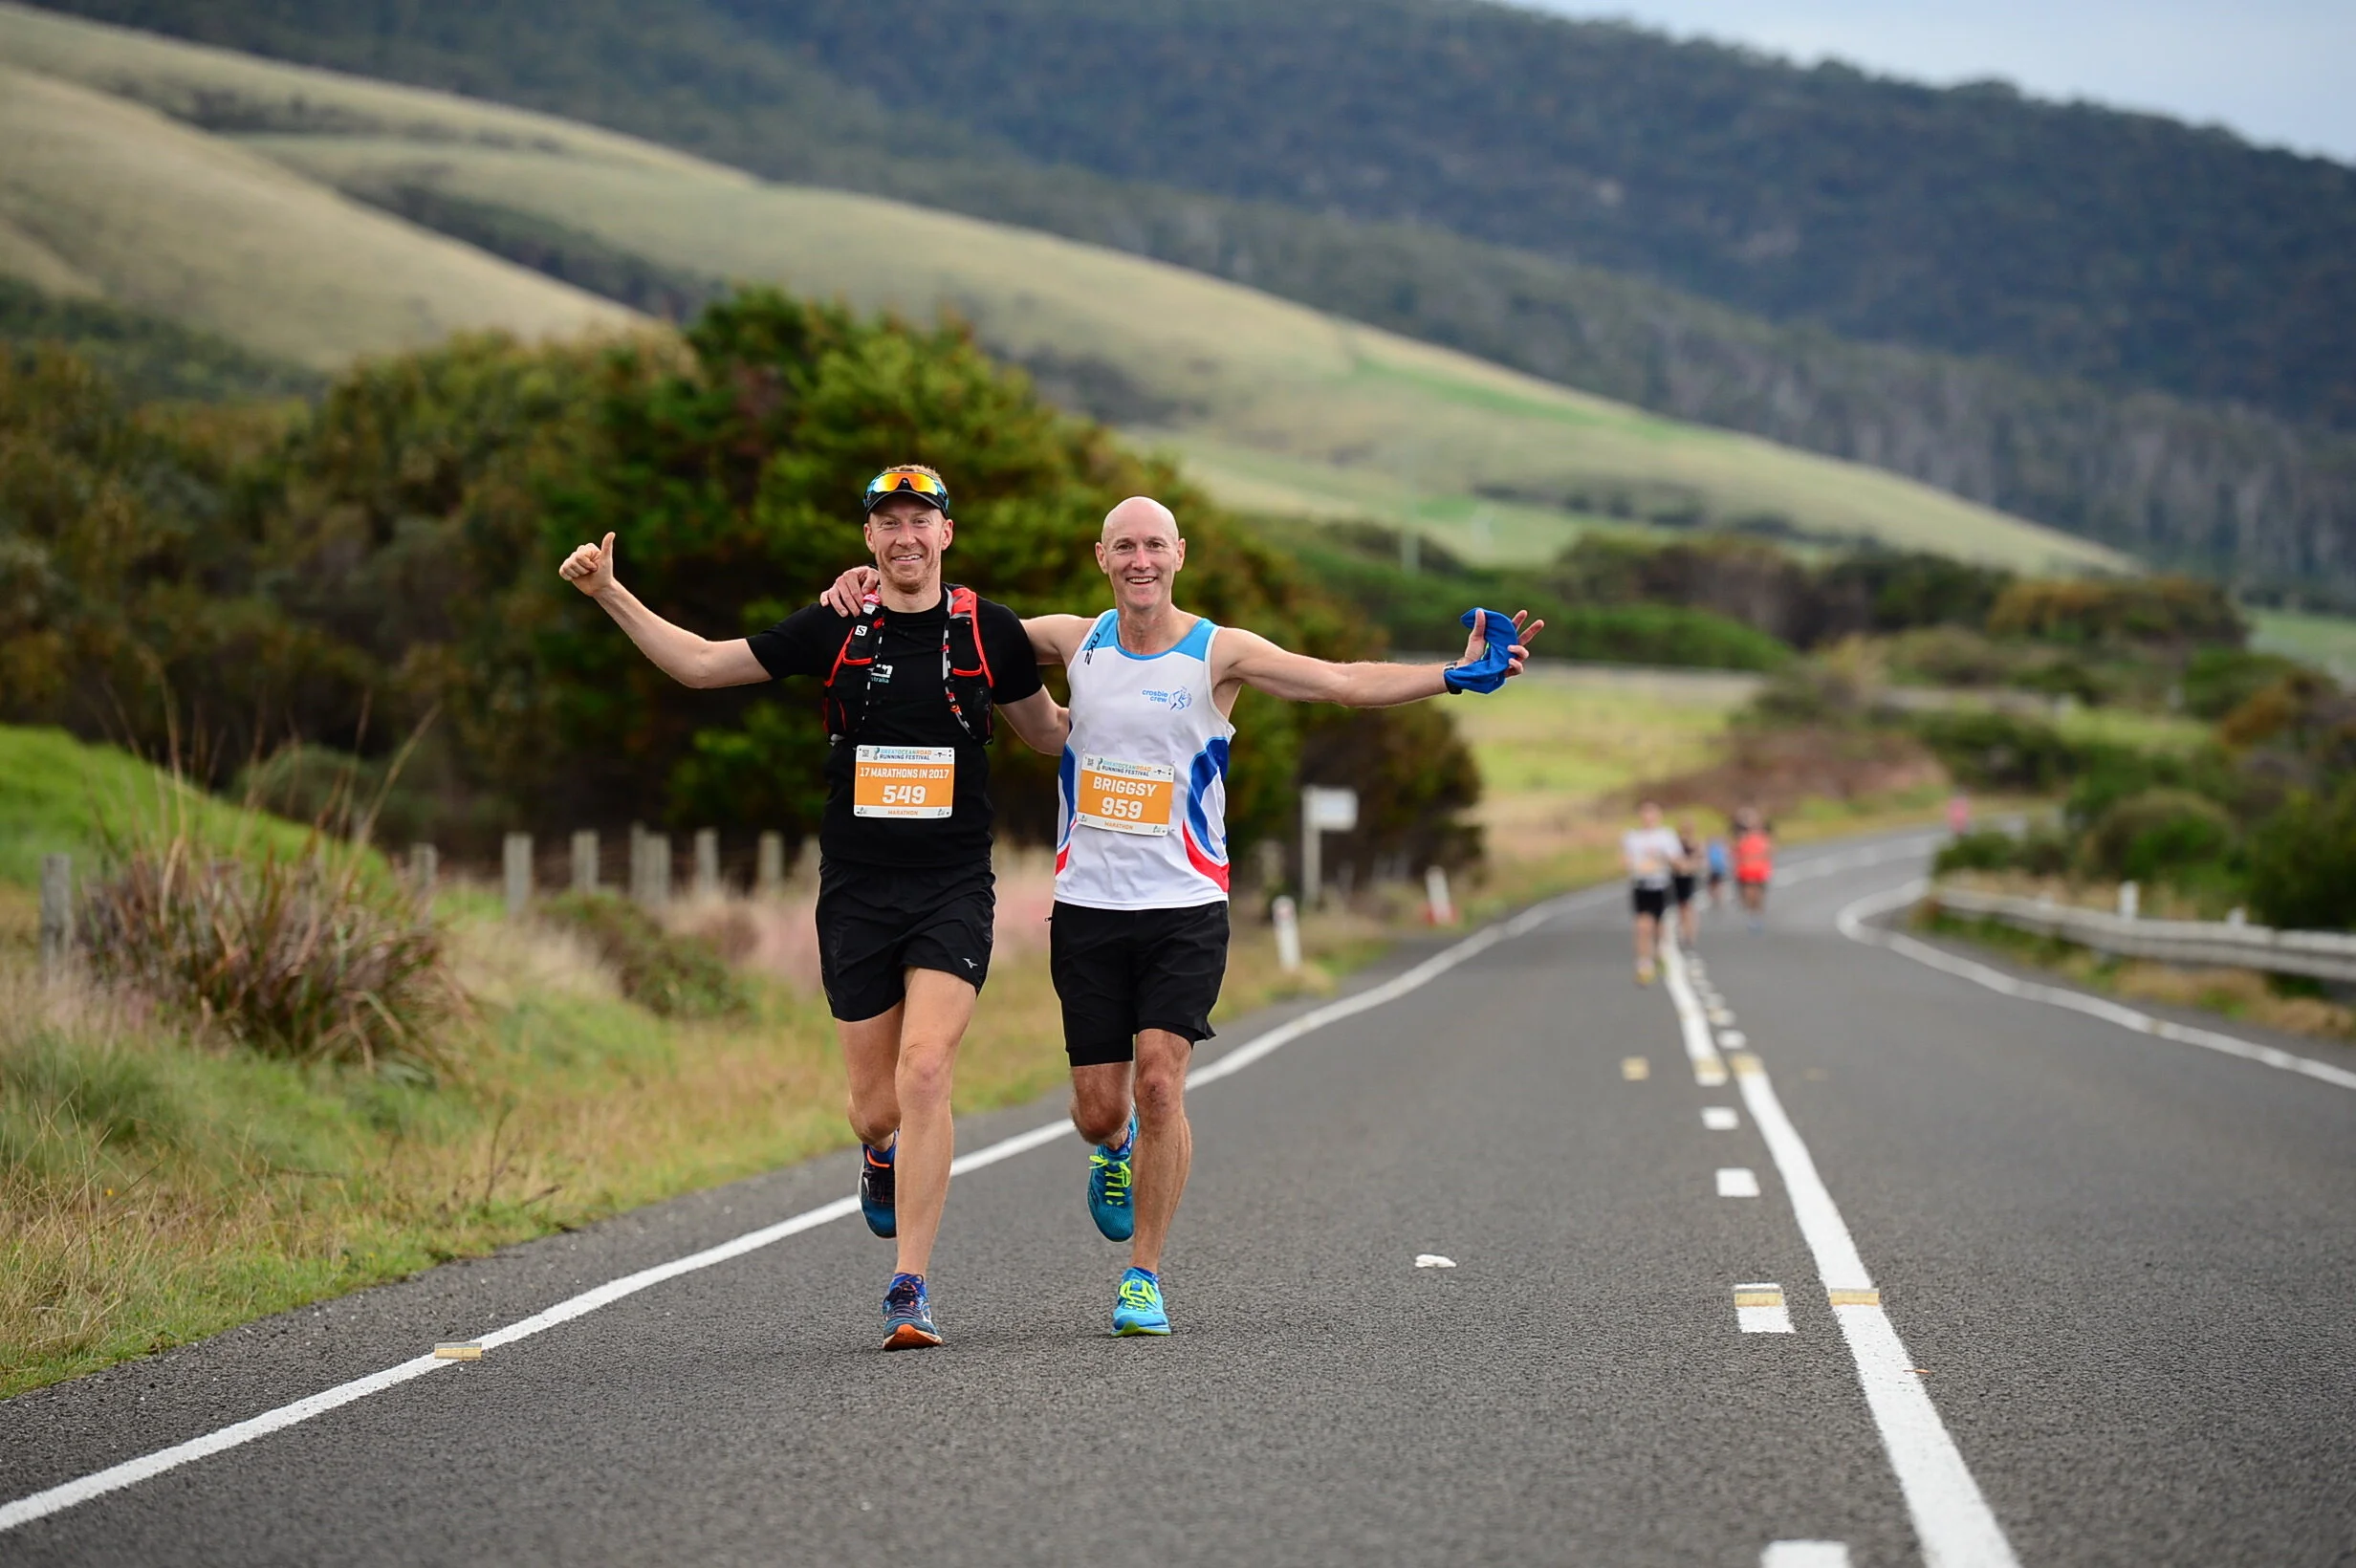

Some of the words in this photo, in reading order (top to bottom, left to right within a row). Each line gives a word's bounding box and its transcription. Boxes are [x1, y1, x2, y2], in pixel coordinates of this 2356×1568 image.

[1142, 689, 1168, 698] crosbie
[1149, 695, 1168, 704] crew
[860, 768, 871, 777] 17
[871, 768, 918, 778] MARATHONS
[919, 769, 927, 778] IN
[928, 770, 949, 779] 2017
[1093, 775, 1158, 797] BRIGGSY
[882, 785, 927, 804] 549
[1101, 796, 1143, 819] 959
[1104, 821, 1133, 830] MARATHON
